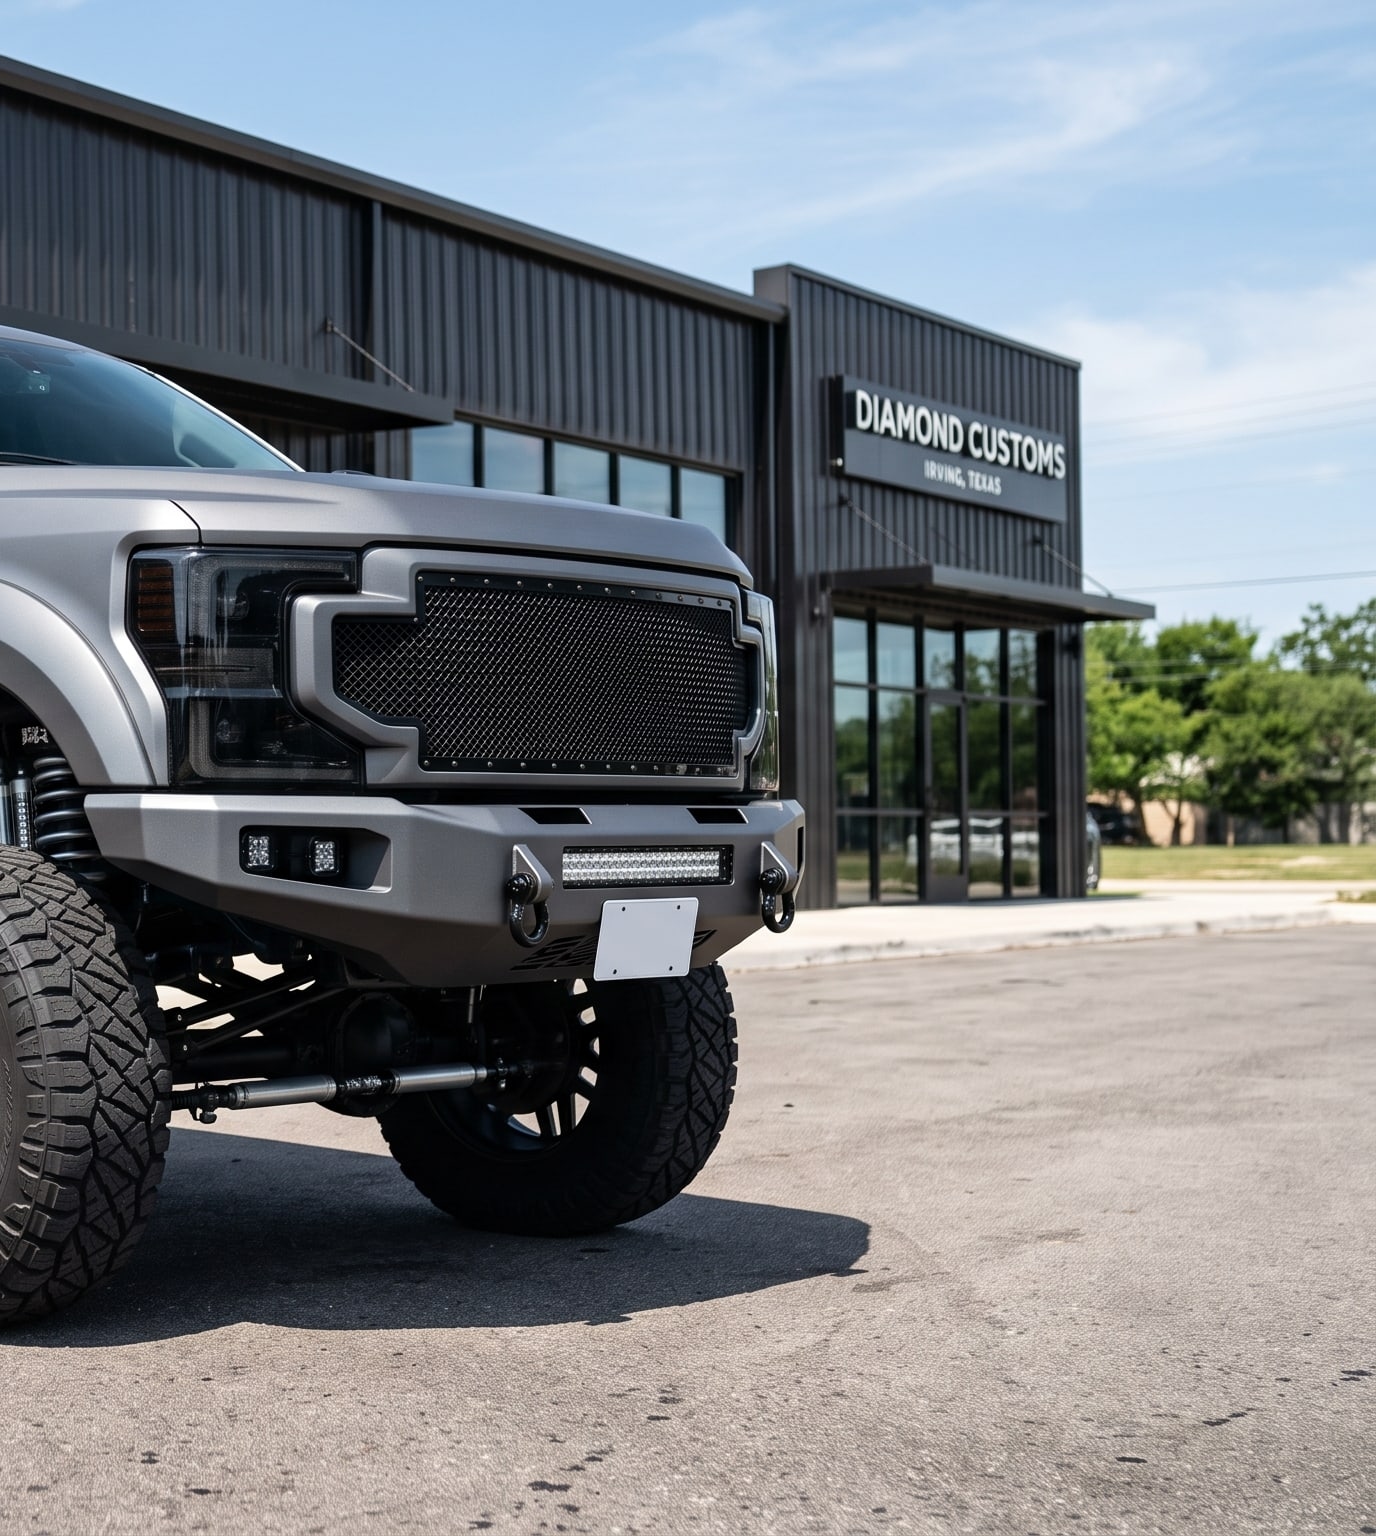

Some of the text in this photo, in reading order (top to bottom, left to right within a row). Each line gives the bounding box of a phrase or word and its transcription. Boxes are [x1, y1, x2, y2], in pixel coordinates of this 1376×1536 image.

[855, 389, 1066, 480] DIAMOND CUSTOMS
[924, 459, 1002, 496] IRVING, TEXAS
